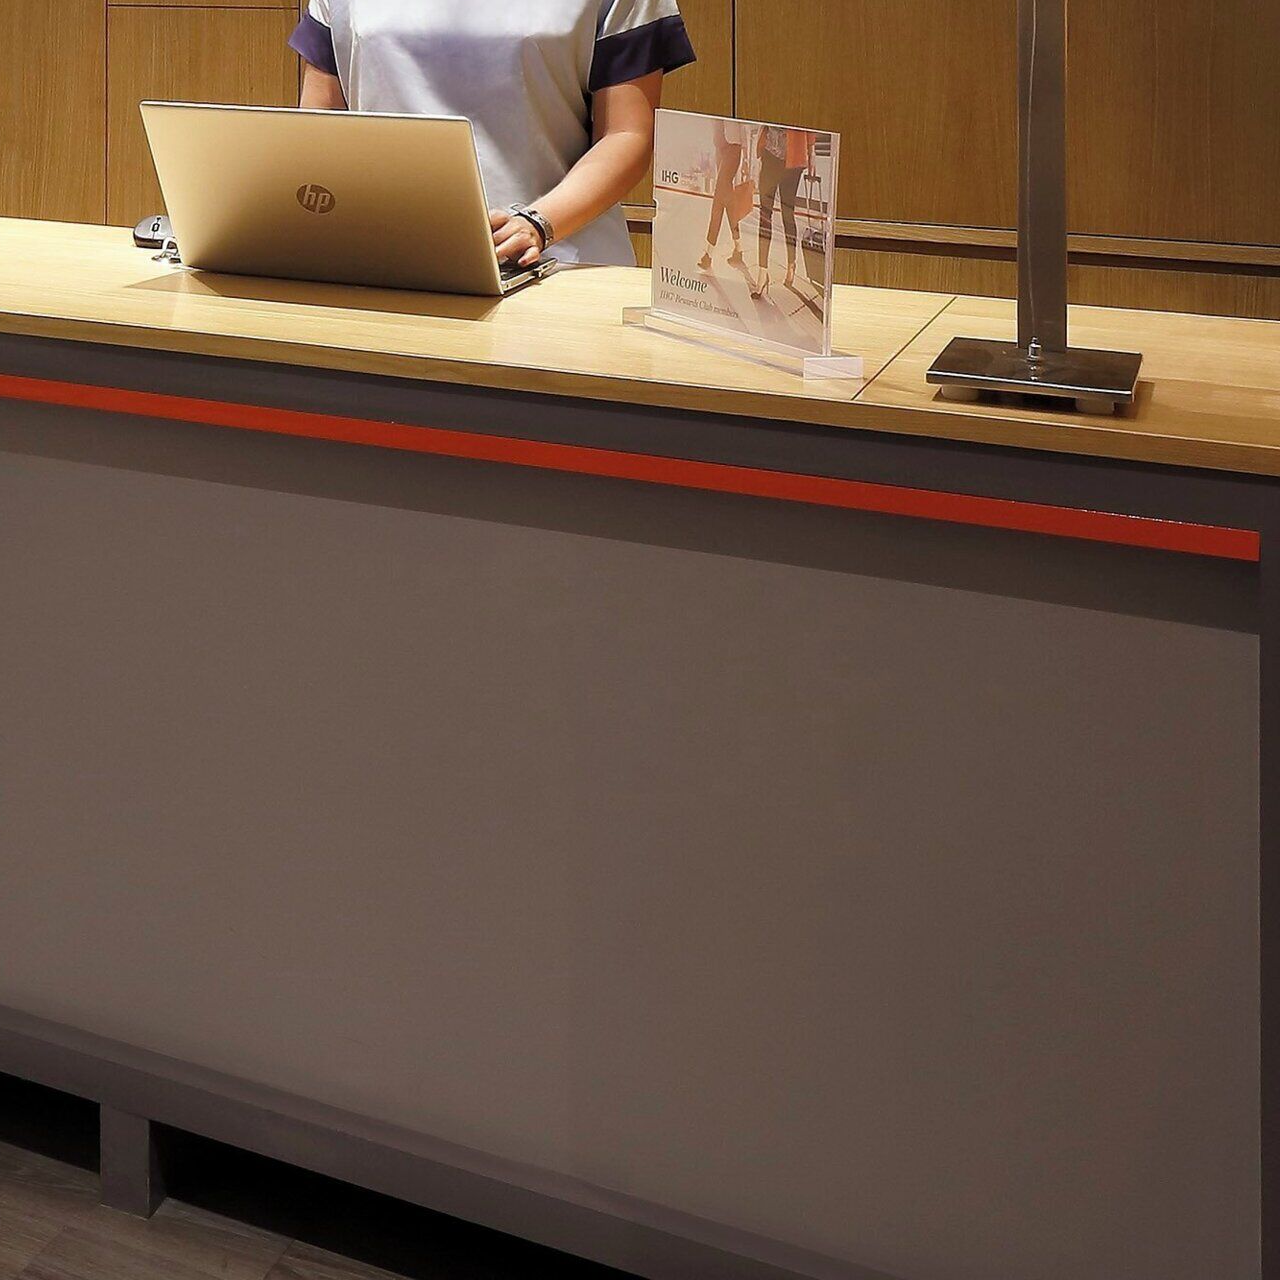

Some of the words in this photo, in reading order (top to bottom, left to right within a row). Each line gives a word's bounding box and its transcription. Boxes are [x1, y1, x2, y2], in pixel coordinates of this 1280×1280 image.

[661, 169, 679, 184] IHG
[302, 184, 331, 214] hp
[660, 266, 708, 293] Welcome
[675, 294, 699, 308] Rewards
[699, 301, 713, 312] Club
[714, 306, 739, 319] members
